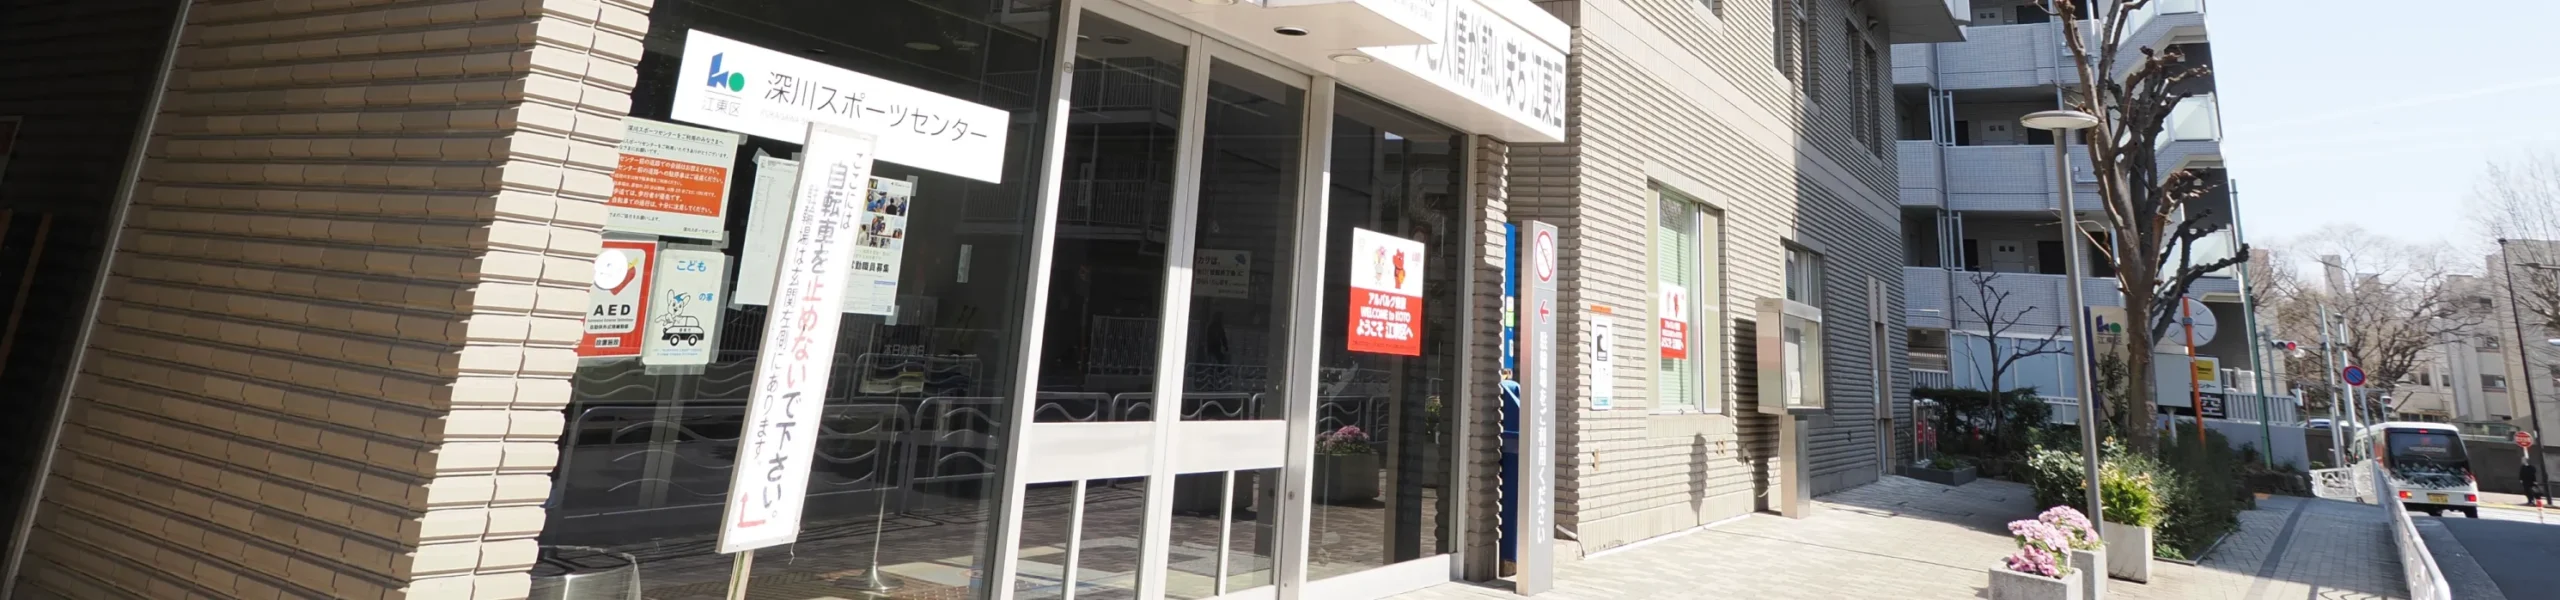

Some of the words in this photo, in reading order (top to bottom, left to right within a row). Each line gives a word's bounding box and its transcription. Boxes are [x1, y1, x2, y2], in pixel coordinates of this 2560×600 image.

[1531, 50, 1563, 128] 江東区
[700, 96, 741, 117] 江東区
[764, 71, 988, 142] 深川スポーツセンター
[840, 152, 864, 230] ここには
[677, 260, 707, 272] こども
[593, 304, 631, 316] AED
[1361, 306, 1389, 320] WELCOME
[1395, 311, 1411, 323] KOTO
[763, 160, 848, 518] 自転車を止めないで下さい。
[1357, 319, 1384, 338] ようこそ
